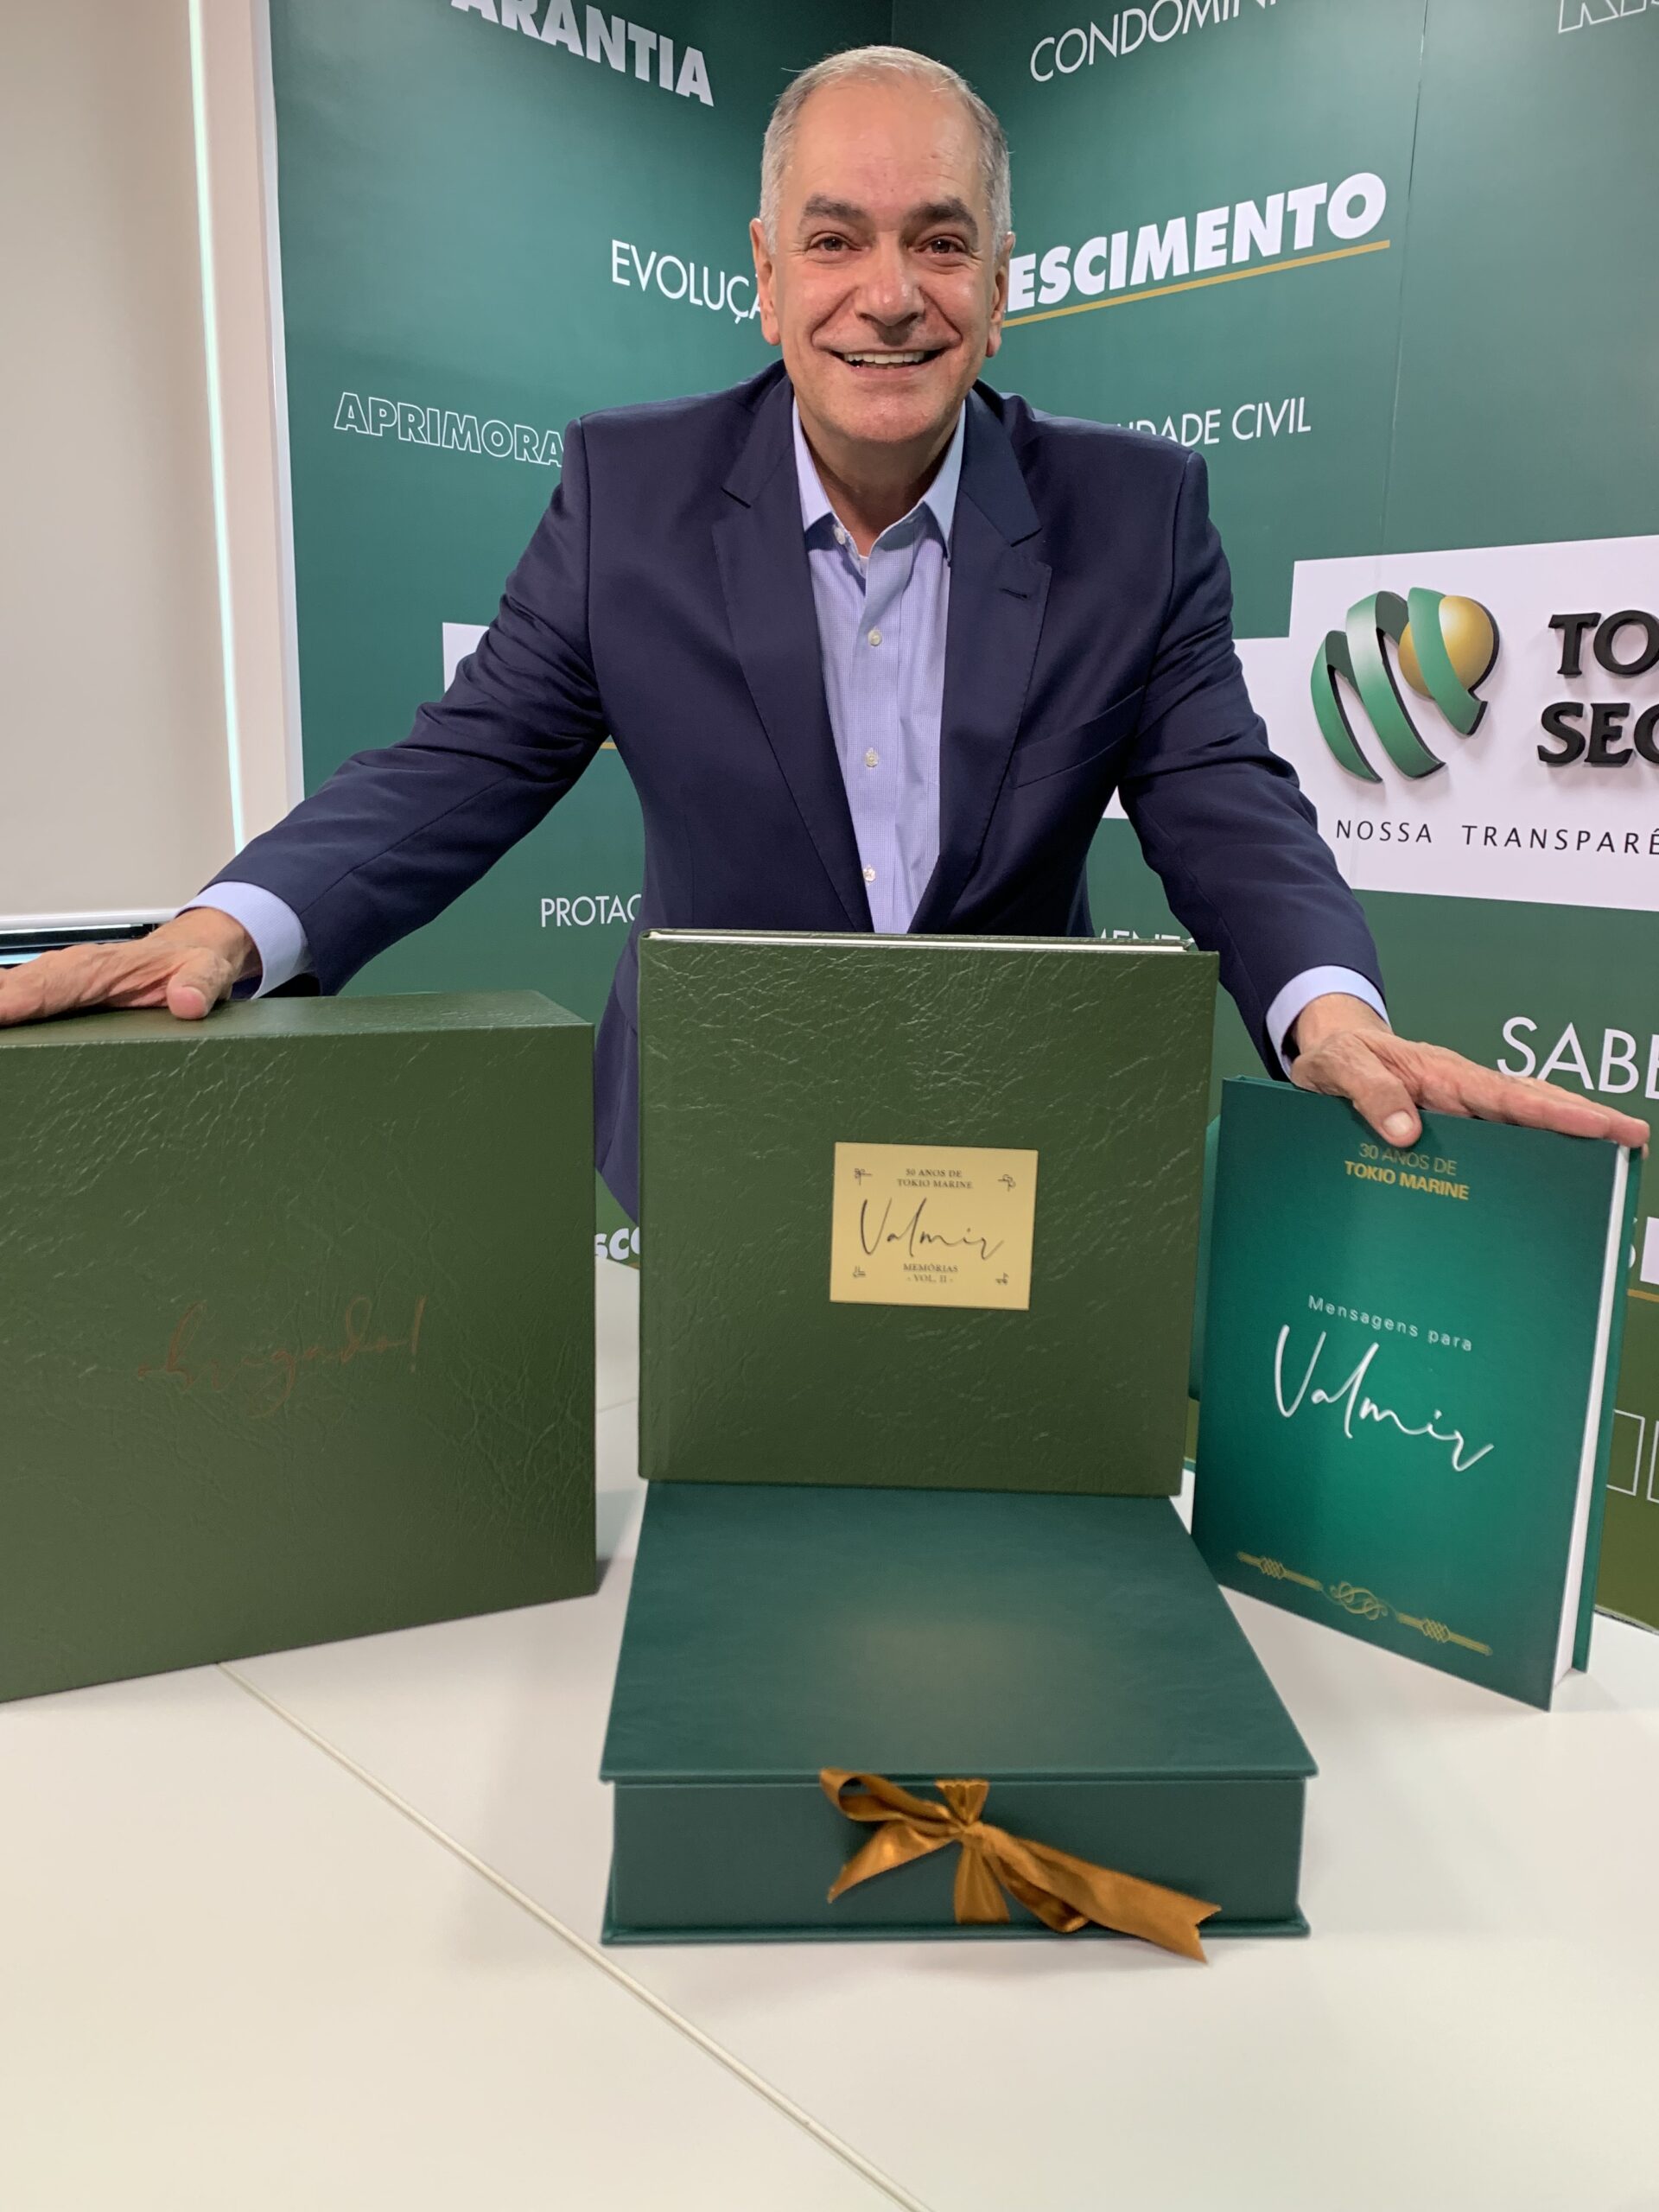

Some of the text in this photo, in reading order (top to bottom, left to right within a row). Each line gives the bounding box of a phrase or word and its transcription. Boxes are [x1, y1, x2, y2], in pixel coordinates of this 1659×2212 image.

[334, 391, 564, 467] APRIMORA
[1231, 397, 1312, 441] CIVIL
[1336, 819, 1433, 844] NOSSA
[948, 1169, 962, 1178] DE
[1344, 1160, 1470, 1200] TOKIO MARINE
[1358, 1142, 1458, 1176] 30 ANOS DE
[897, 1178, 973, 1189] TOKIO MARINE
[861, 1198, 1004, 1260] Valmir
[1308, 1294, 1471, 1352] Mensagens para
[1274, 1324, 1494, 1472] Valmir
